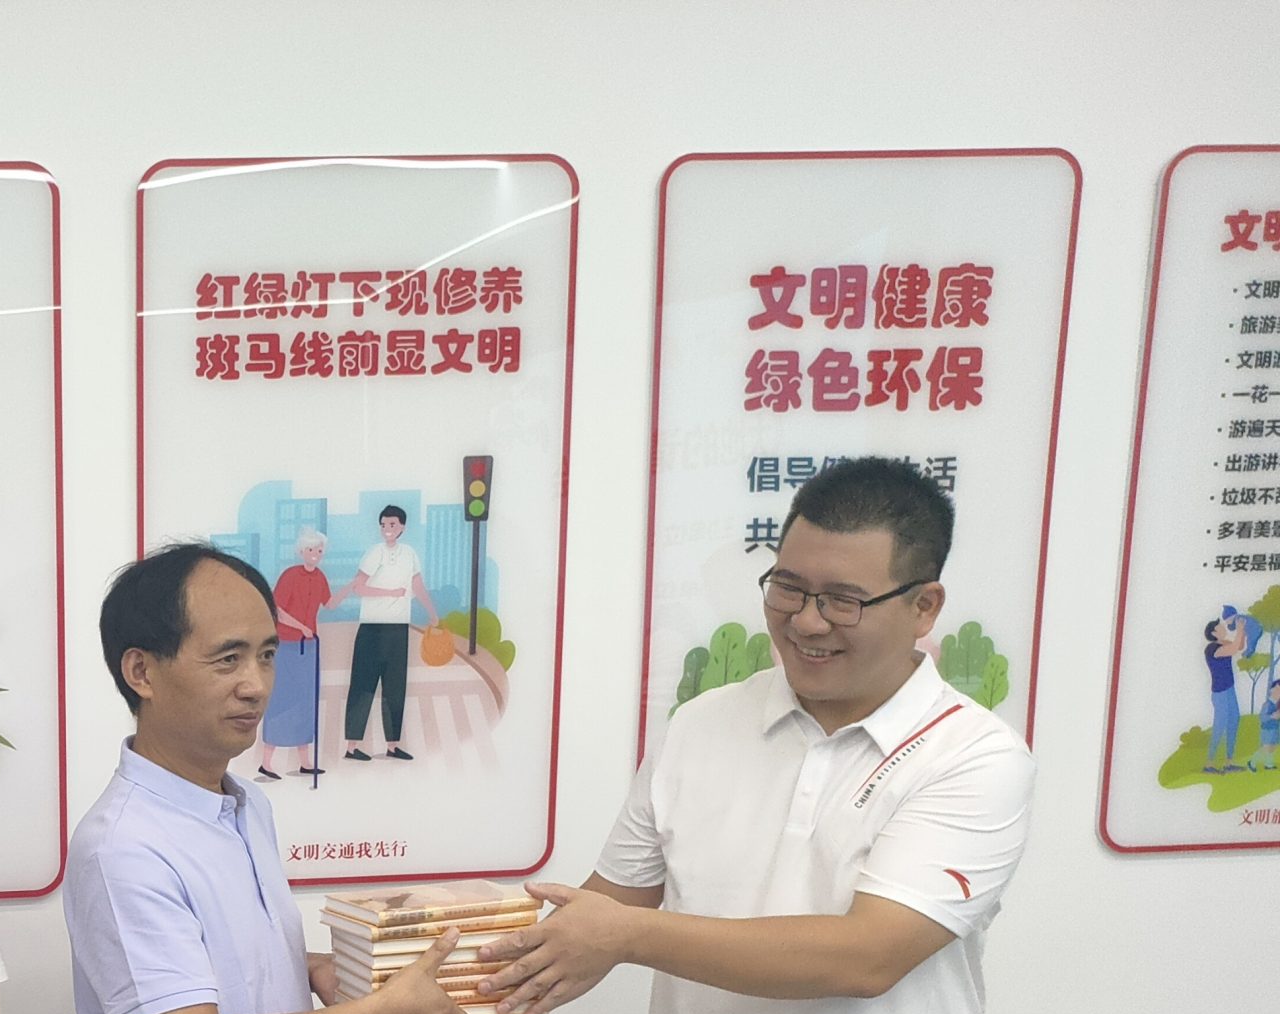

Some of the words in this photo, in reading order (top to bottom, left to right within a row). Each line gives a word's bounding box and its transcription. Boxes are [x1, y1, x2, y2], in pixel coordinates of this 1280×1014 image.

[196, 267, 522, 320] 红绿灯下现修养
[749, 263, 993, 330] 文明健康
[1240, 315, 1280, 335] 旅游
[196, 327, 521, 381] 斑马线前显文明
[746, 347, 984, 412] 绿色环保
[1224, 452, 1280, 473] 出游讲
[854, 783, 876, 809] CHINA
[287, 840, 408, 863] 文明交通我先行
